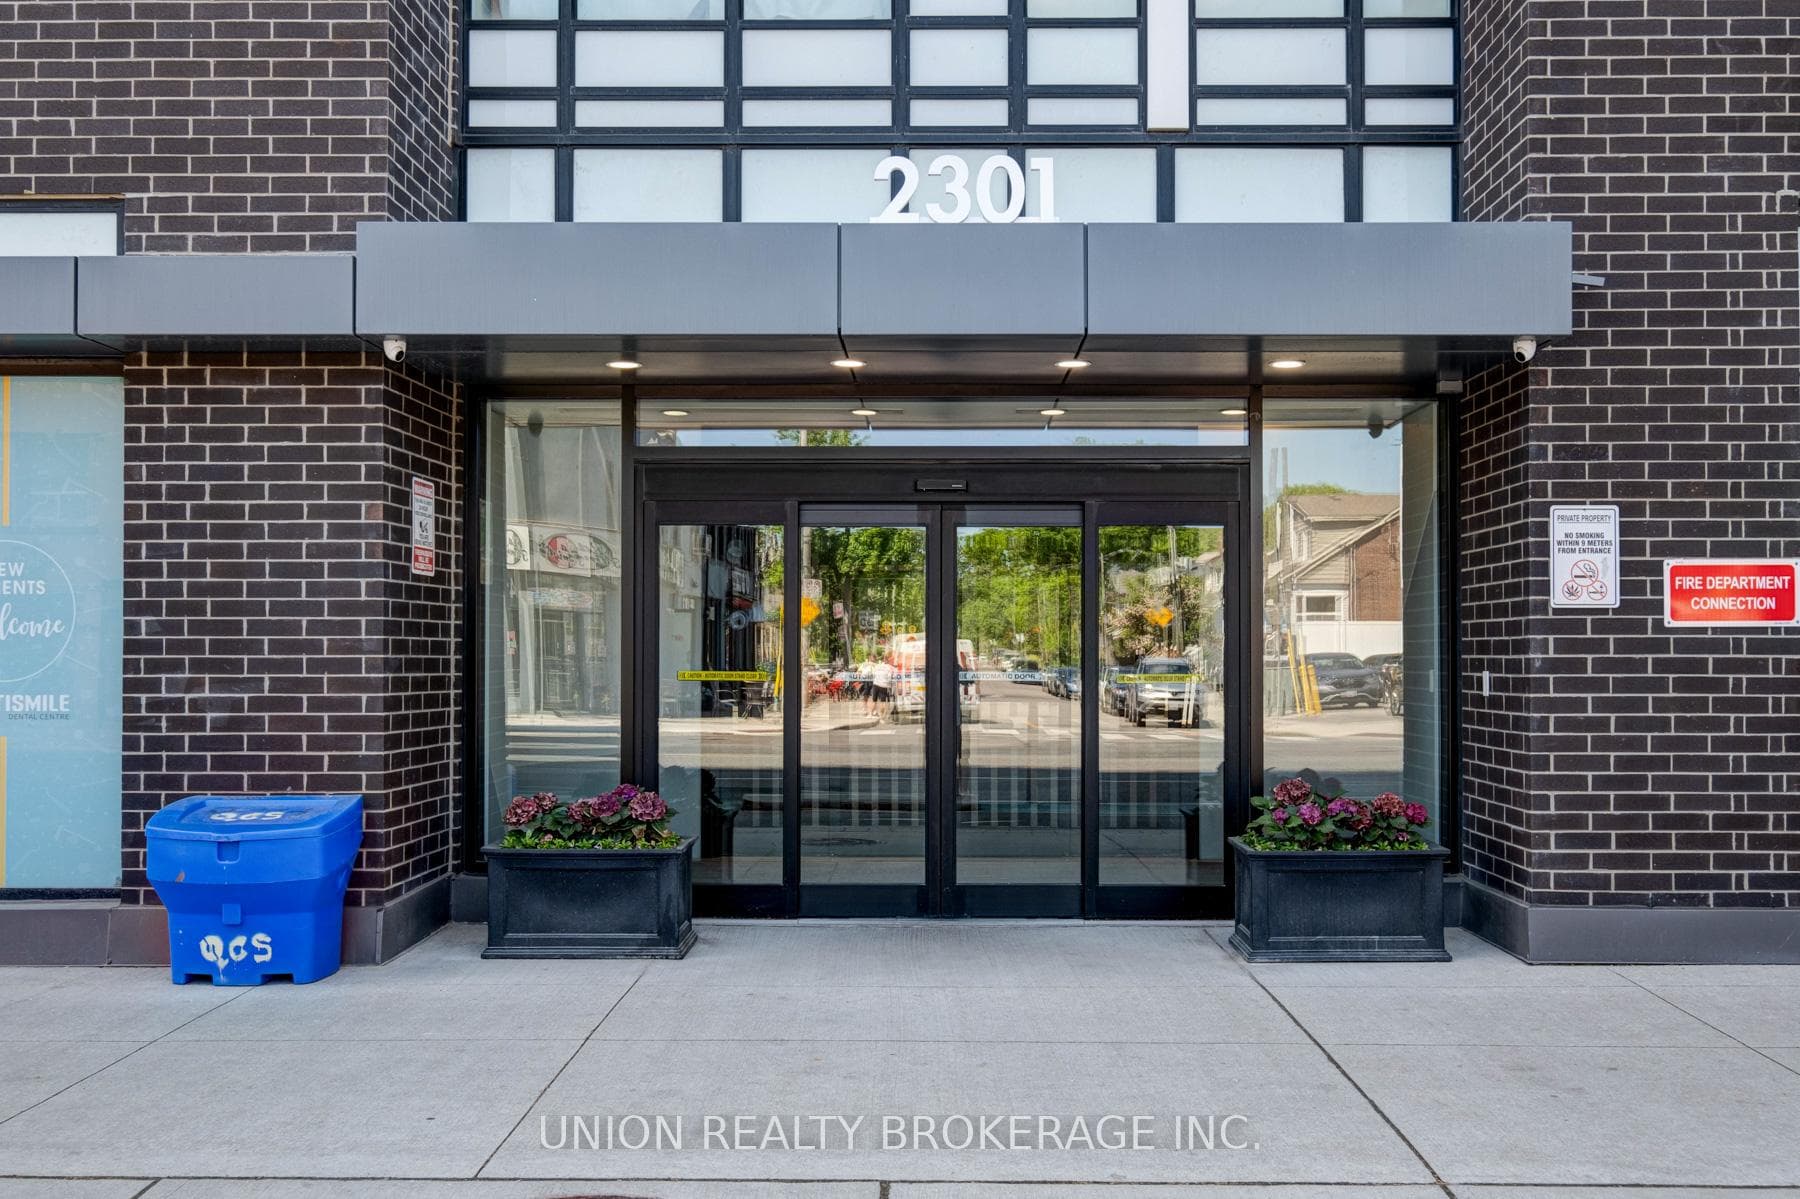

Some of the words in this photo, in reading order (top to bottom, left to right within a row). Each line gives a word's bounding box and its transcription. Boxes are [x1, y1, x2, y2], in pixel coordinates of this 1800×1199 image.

[869, 154, 1056, 223] 2301
[1557, 514, 1580, 522] PRIVATE
[1581, 514, 1612, 522] PROPERTY
[0, 580, 46, 595] ENTS
[1675, 576, 1703, 589] FIRE
[1706, 576, 1791, 589] DEPARTMENT
[1691, 597, 1776, 610] CONNECTION
